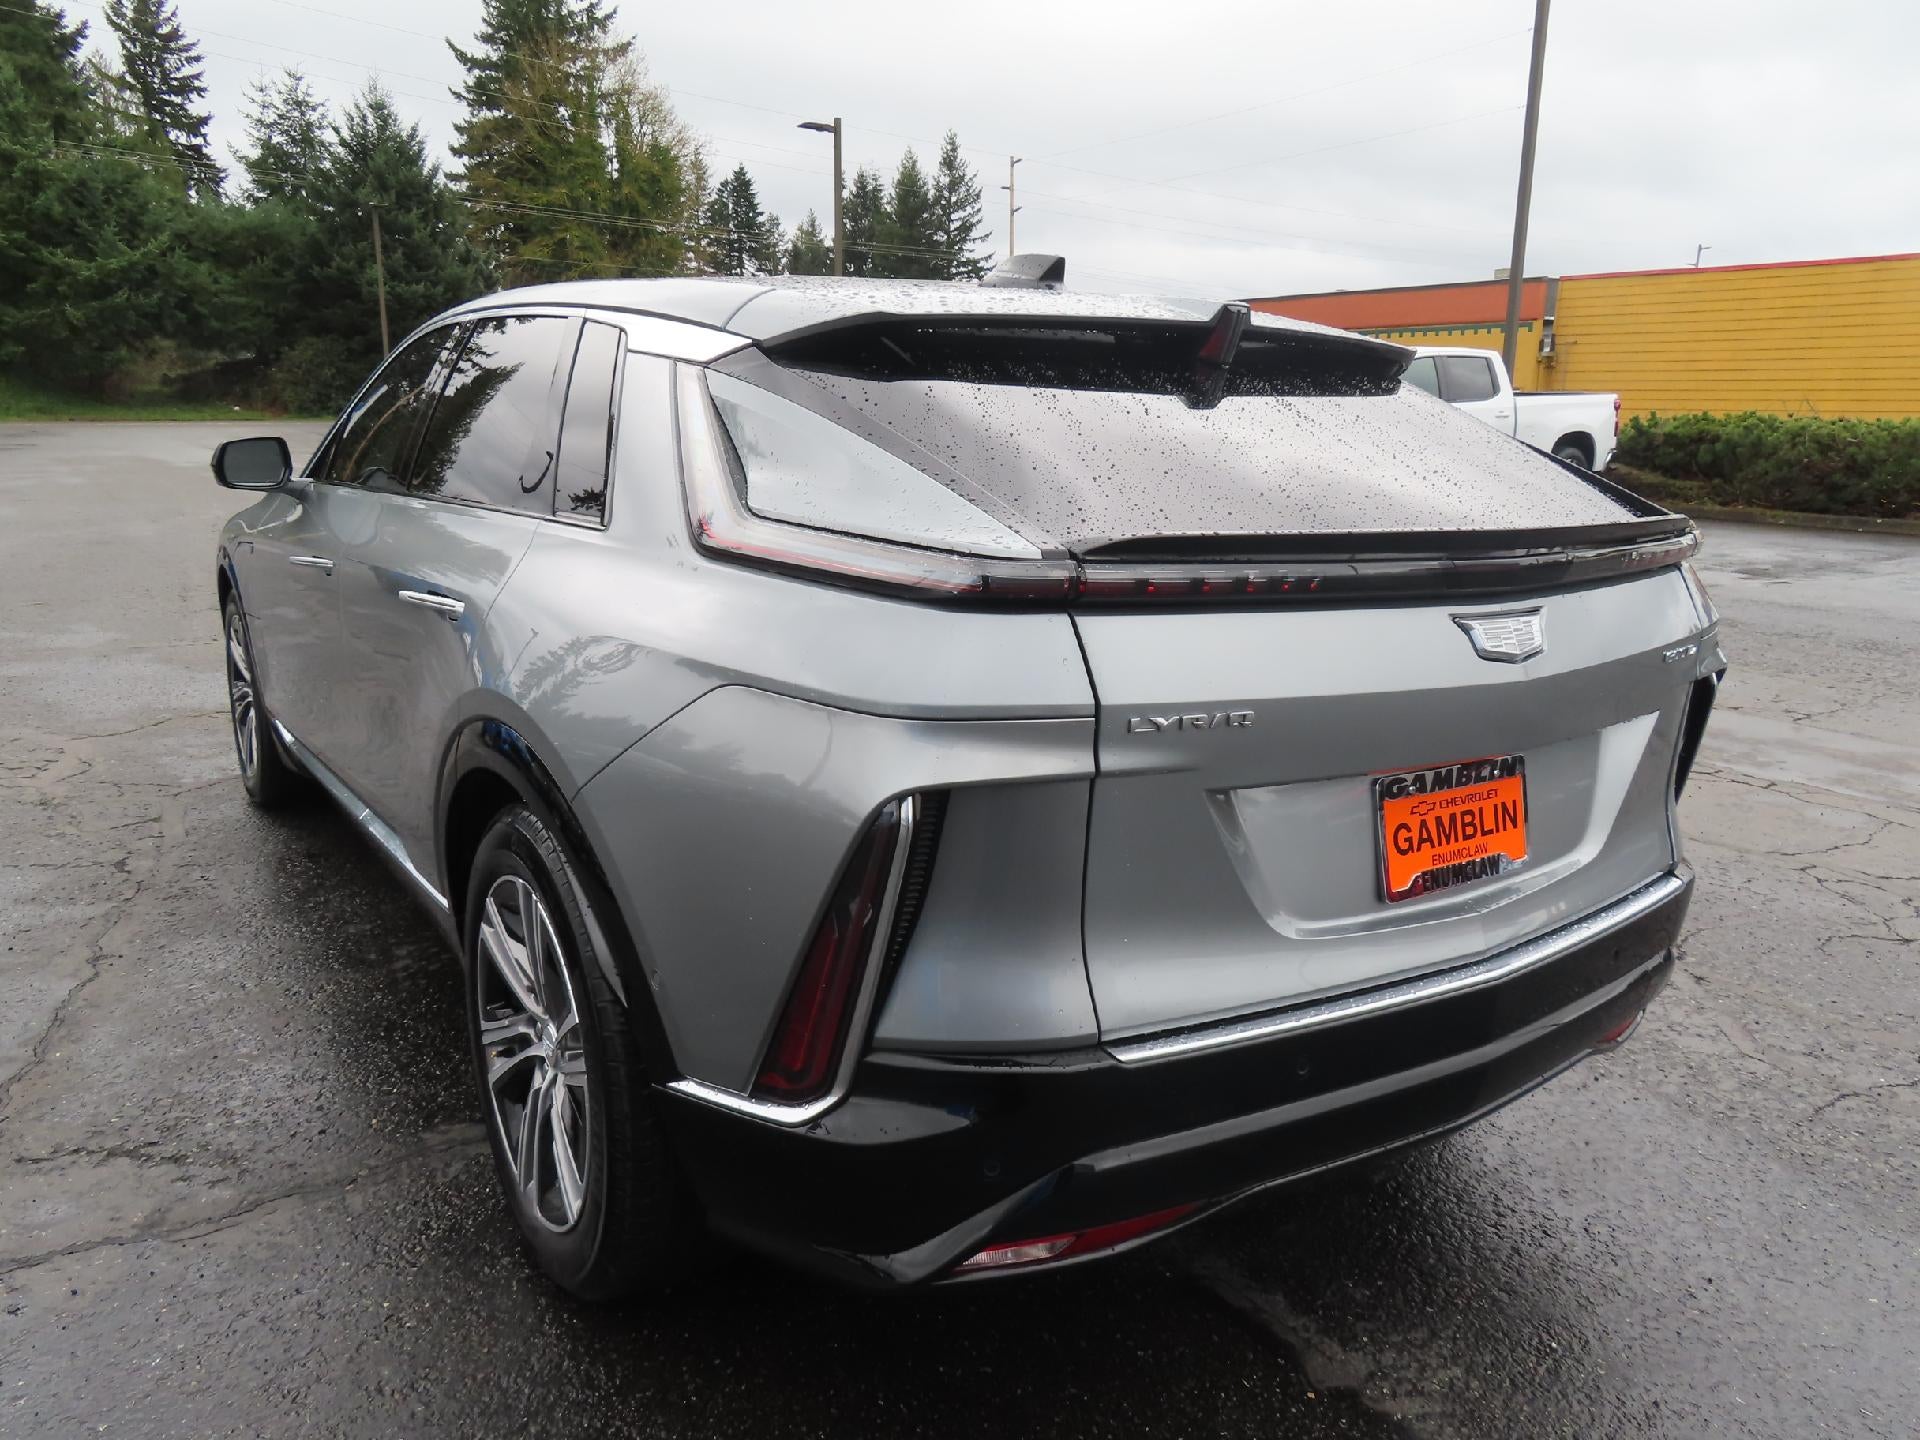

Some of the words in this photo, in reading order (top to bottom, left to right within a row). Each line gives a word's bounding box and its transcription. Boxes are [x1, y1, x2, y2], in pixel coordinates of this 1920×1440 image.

[1385, 757, 1518, 799] GAMBLIN
[1439, 788, 1499, 809] CHEVROLET
[1393, 799, 1518, 856] GAMBLIN
[1431, 842, 1488, 866] ENUMCLAW
